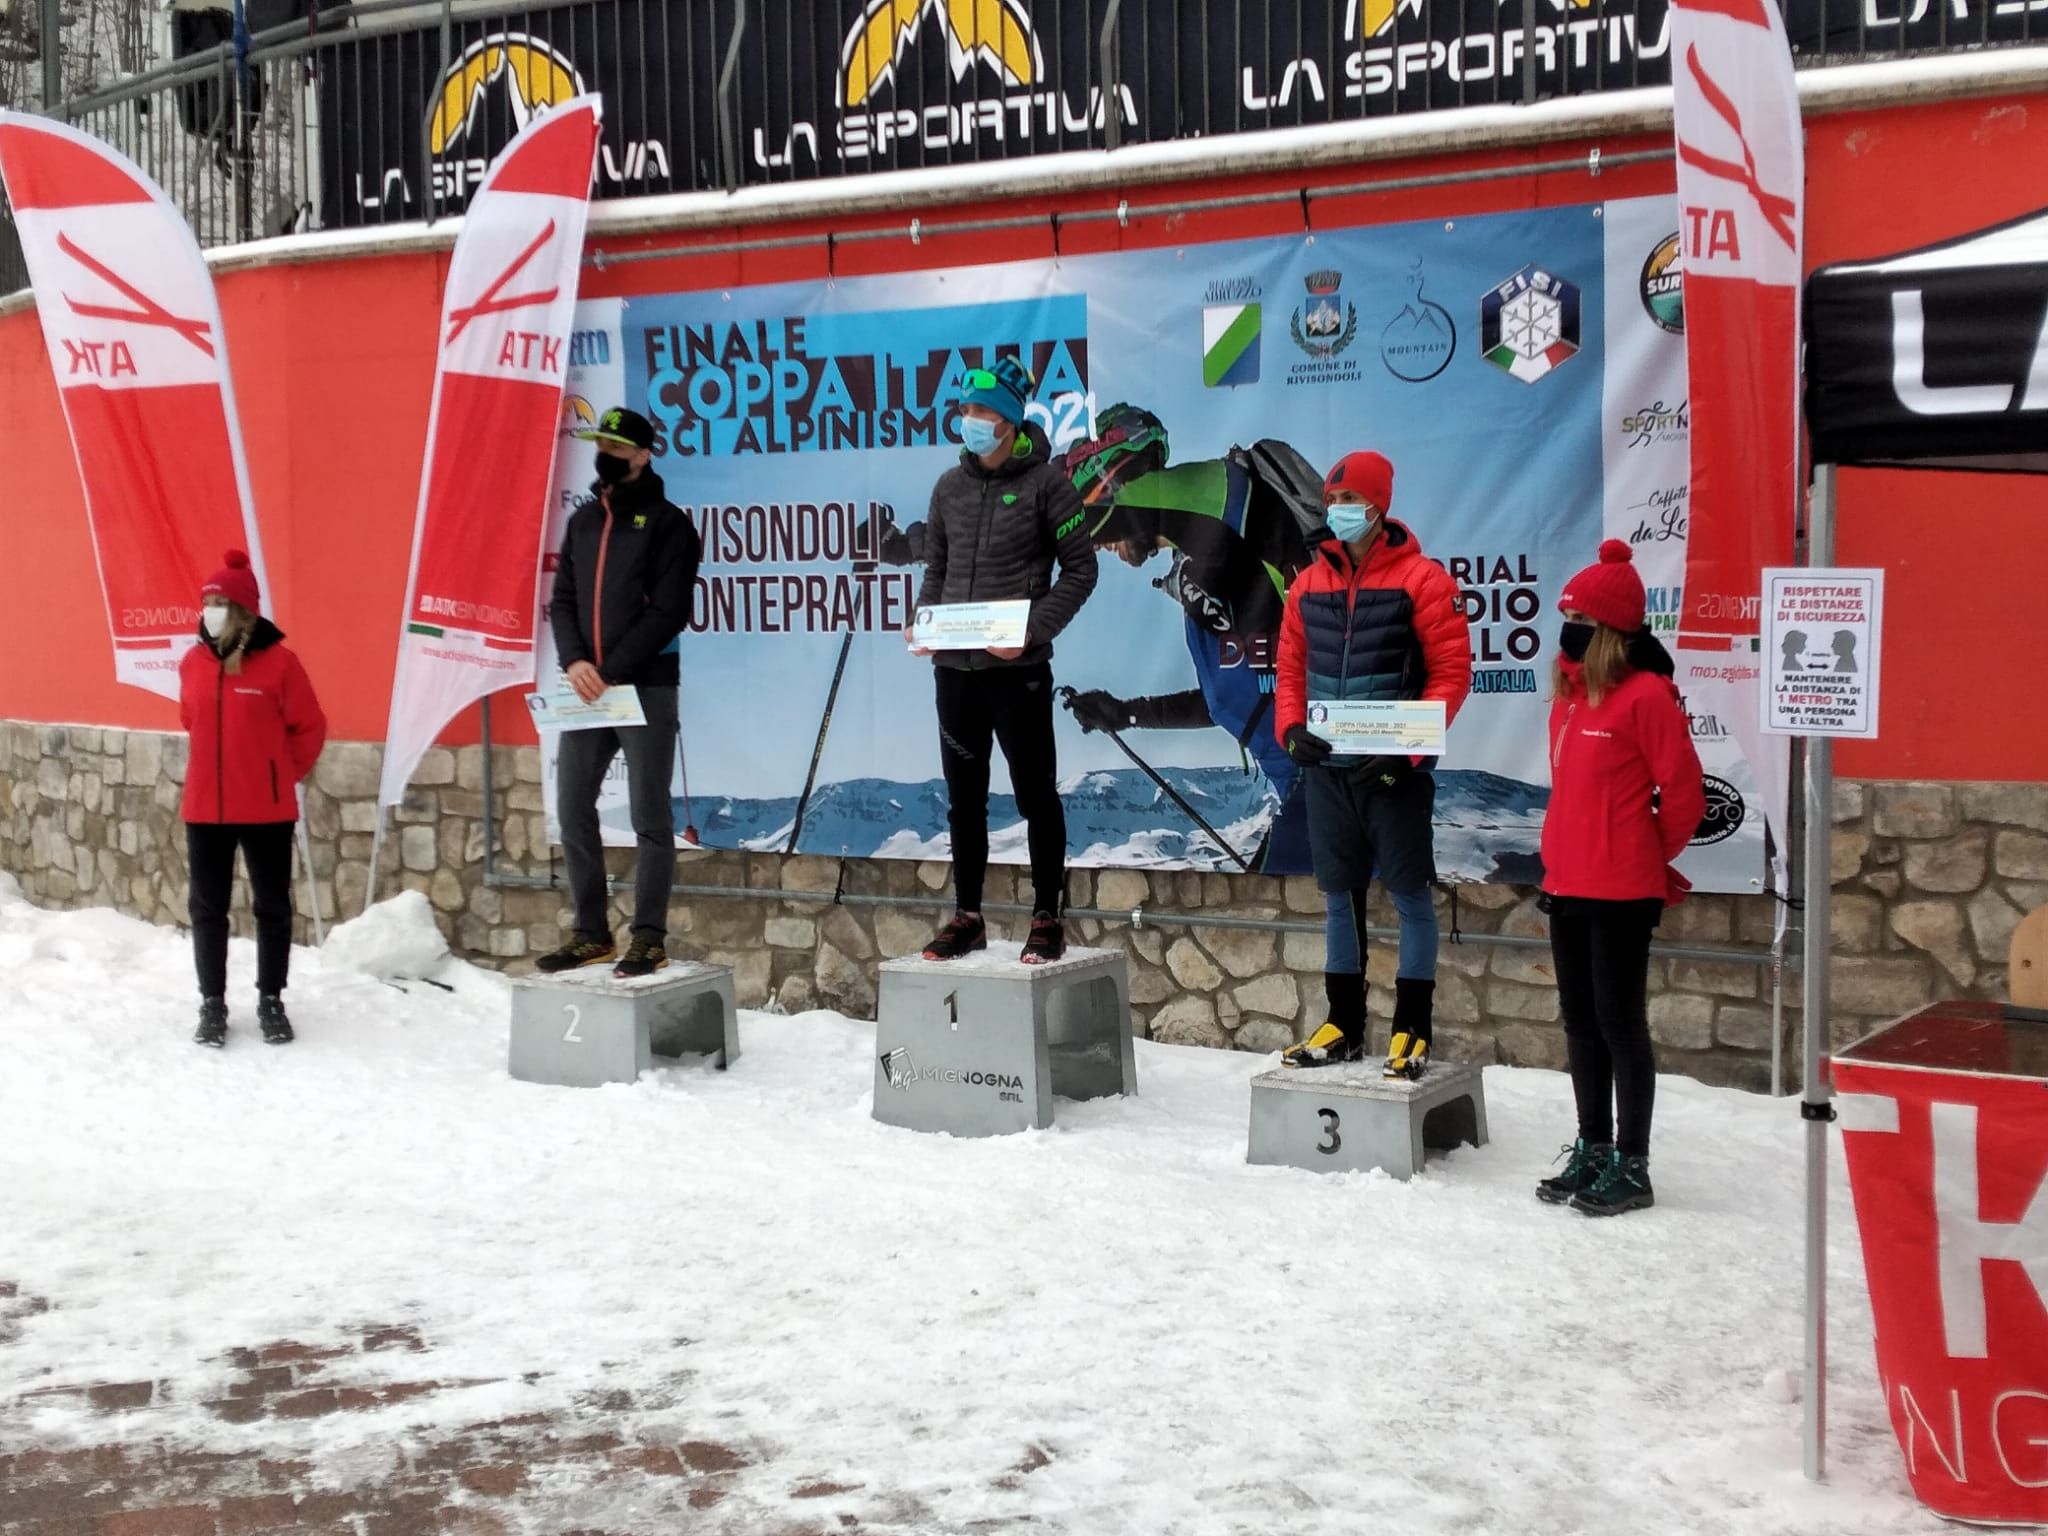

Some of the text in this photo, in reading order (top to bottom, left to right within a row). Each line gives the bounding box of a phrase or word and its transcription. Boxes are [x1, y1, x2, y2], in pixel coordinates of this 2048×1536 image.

[1243, 12, 1670, 111] LA SPORTIV
[754, 83, 1139, 168] LA SPORTIVA
[355, 168, 411, 208] LA
[1499, 271, 1563, 302] FISI
[1646, 276, 1681, 296] SUR
[499, 330, 563, 374] ATK
[643, 316, 807, 370] FINALE
[1388, 344, 1448, 354] MOUNTAIN
[1286, 371, 1362, 385] RIVISONDOLI
[1291, 360, 1357, 373] COMUNE DI
[649, 355, 856, 423] COPPA
[1621, 414, 1688, 433] SPORTN
[650, 415, 712, 458] SCI
[688, 501, 880, 563] VISONDOLI
[1783, 586, 1862, 598] RISPETTARE
[1777, 611, 1866, 622] DI SICUREZZA
[1781, 599, 1863, 610] LE DISTANZE
[1775, 684, 1861, 695] LA DISTANZA DI
[1784, 674, 1852, 684] MANTENERE
[1778, 694, 1858, 706] 1 METRO TRA
[1778, 705, 1856, 716] UNA PERSONA
[1790, 716, 1844, 726] E L'ALTRA
[1702, 777, 1740, 803] ONDO
[943, 989, 958, 1032] 1
[562, 1003, 583, 1043] 2
[921, 1066, 1024, 1090] MIGNOGNA
[1316, 1107, 1342, 1155] 3
